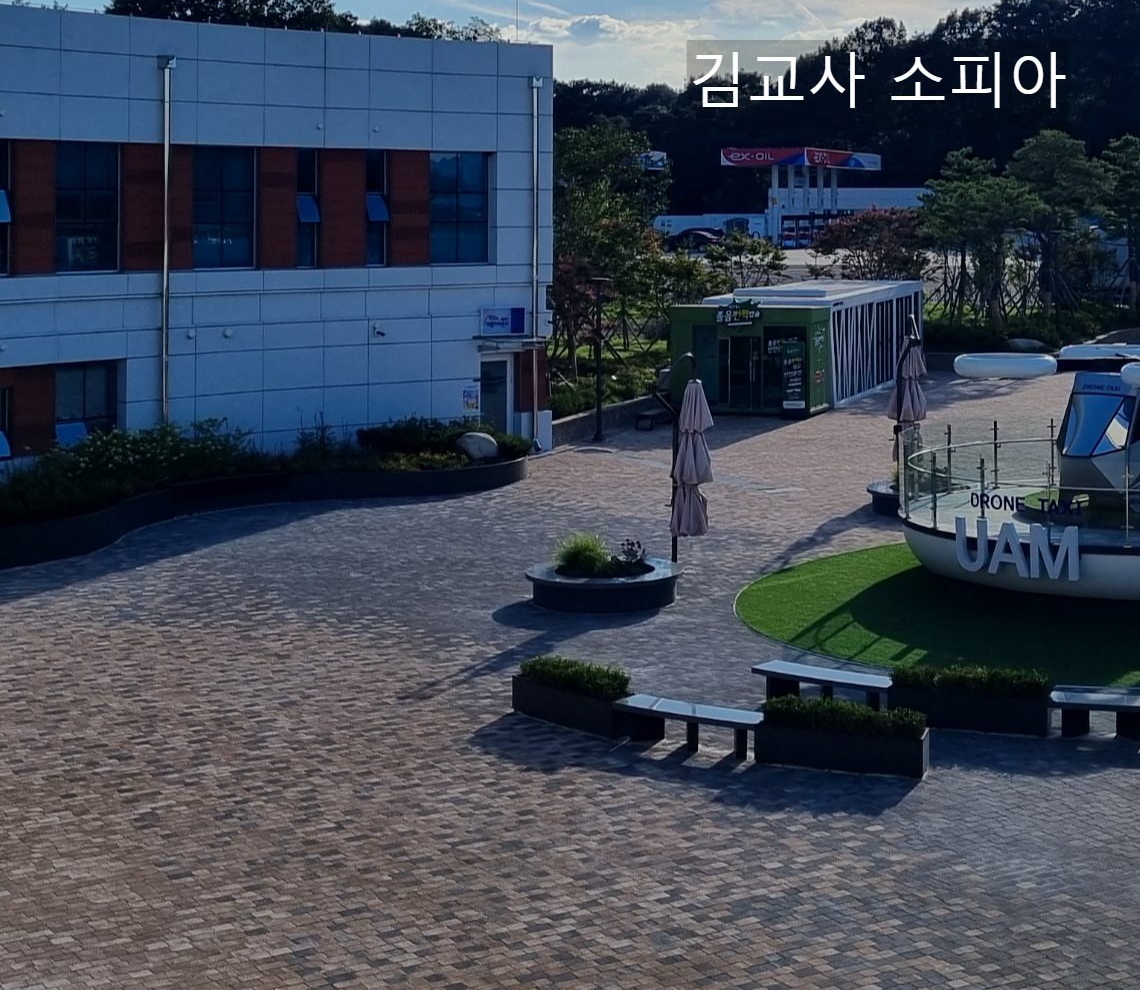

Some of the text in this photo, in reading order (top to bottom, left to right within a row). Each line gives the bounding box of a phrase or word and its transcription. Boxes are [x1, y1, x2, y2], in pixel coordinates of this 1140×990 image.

[1082, 383, 1121, 392] DRONE TAXI
[970, 492, 1083, 516] DRONE TAXI
[955, 515, 1081, 581] UAM
